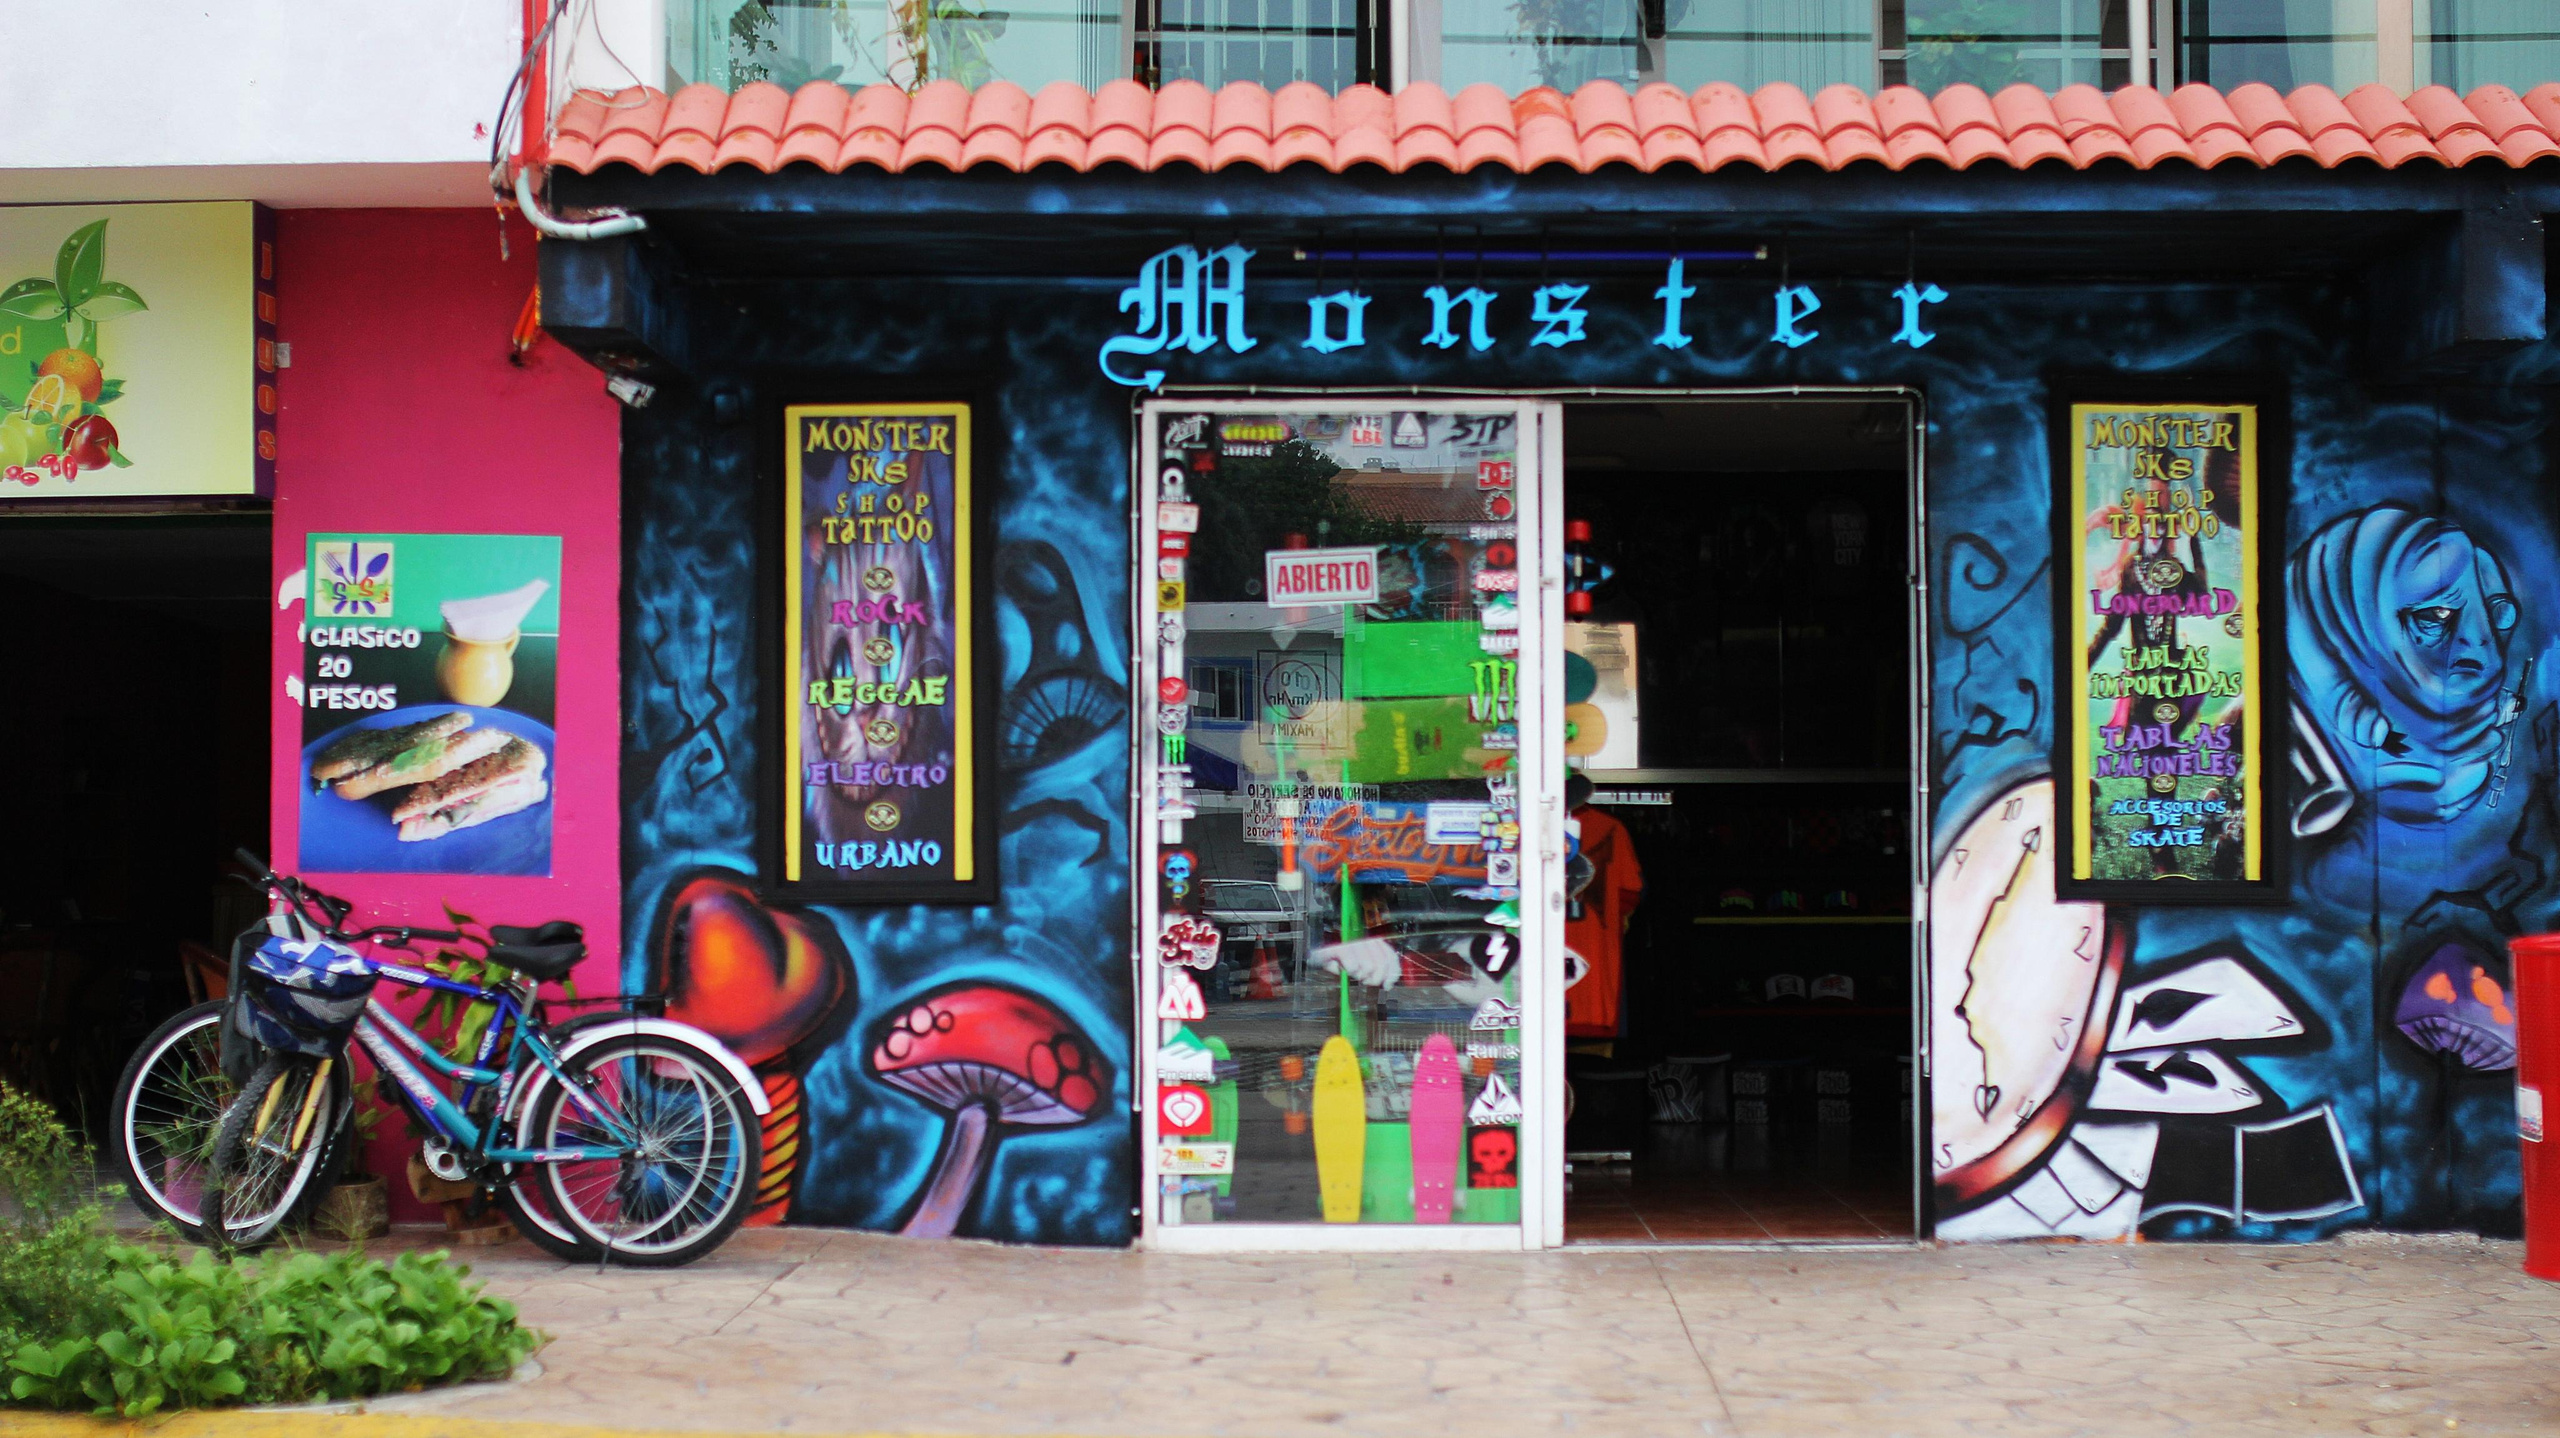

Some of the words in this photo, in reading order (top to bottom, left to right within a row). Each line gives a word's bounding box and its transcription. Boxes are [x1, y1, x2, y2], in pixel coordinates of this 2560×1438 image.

[1099, 243, 1949, 390] Monster
[804, 419, 953, 455] MONSTER
[2087, 415, 2238, 451] MONSTER
[847, 452, 909, 486] SK8
[2132, 451, 2194, 481] SK8
[1834, 548, 1862, 566] CITY
[1276, 561, 1370, 594] ABIERTO
[830, 594, 928, 628] ROCK
[318, 655, 353, 679] 20
[2120, 644, 2210, 671] TABLAS
[308, 685, 397, 710] PESOS
[807, 674, 950, 709] REGGAE
[2099, 722, 2233, 752] TABLAS
[807, 761, 948, 789] ELECTRO
[2152, 812, 2183, 827] DE
[2128, 826, 2206, 848] SKATE
[815, 837, 942, 871] URBANO
[2073, 926, 2095, 962] 2
[356, 1024, 429, 1098] JAGUAR
